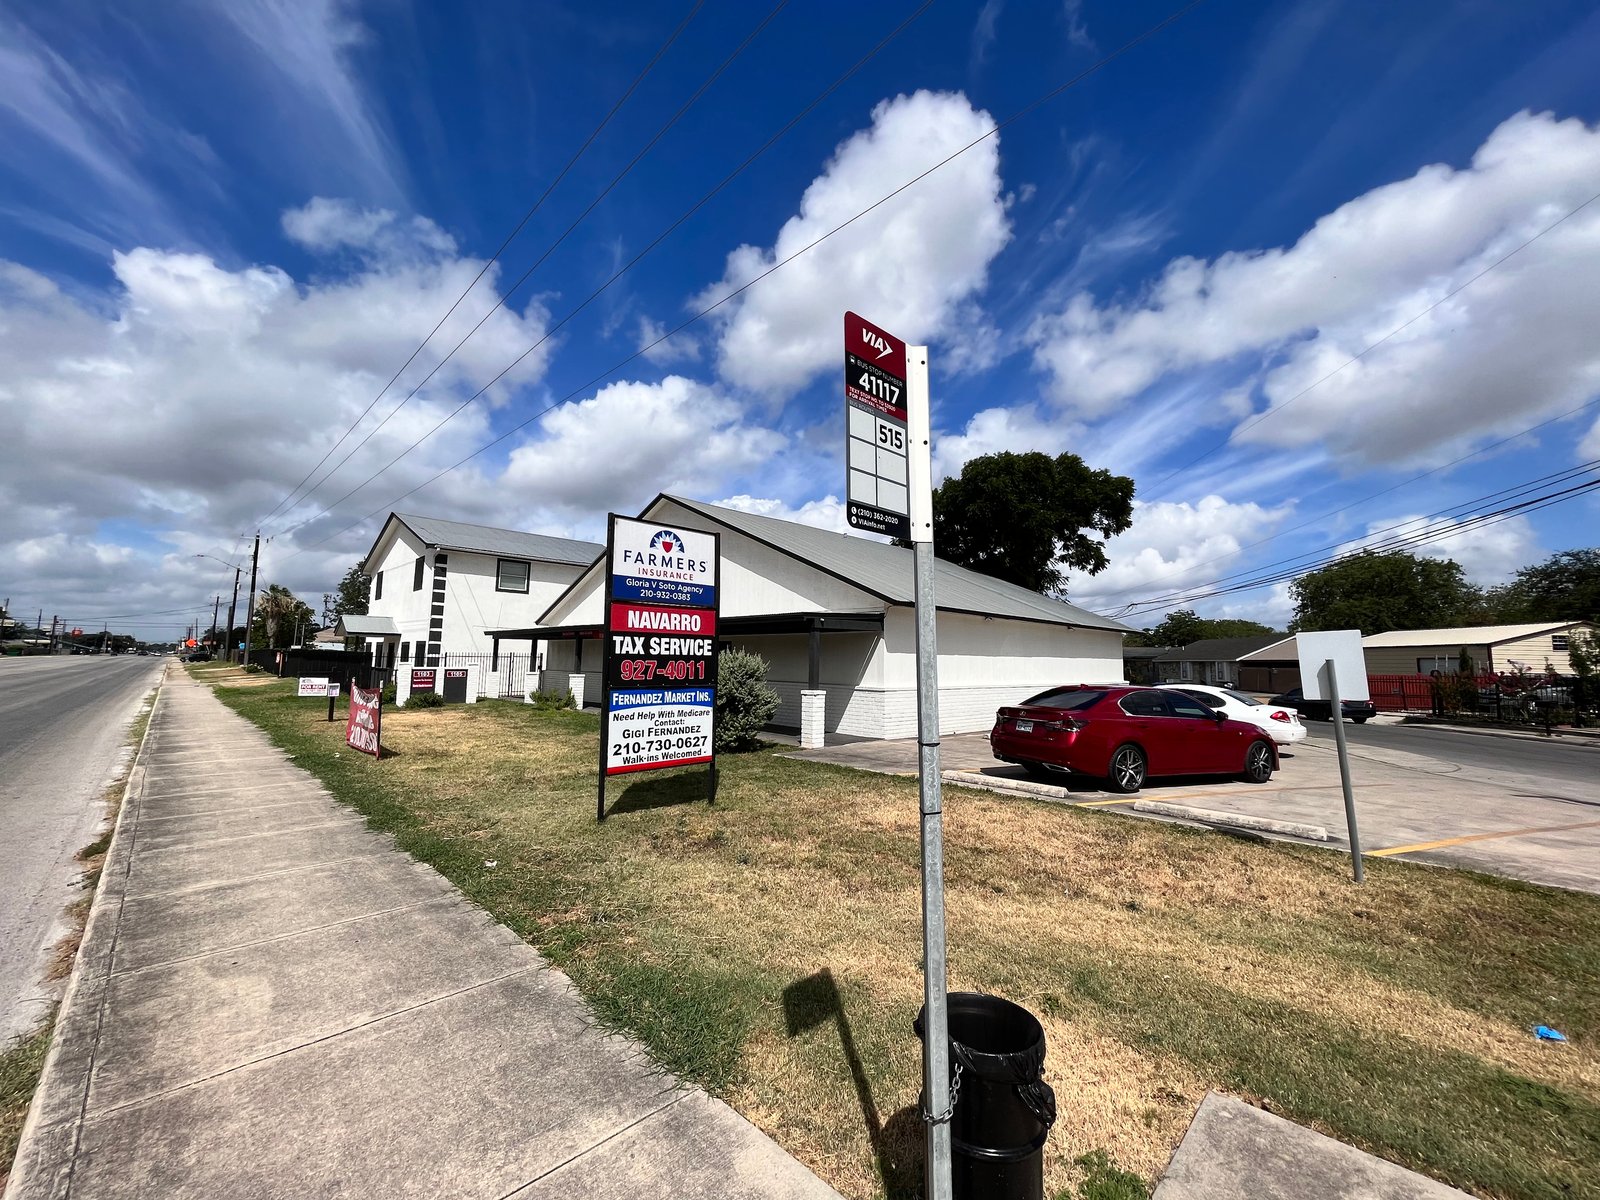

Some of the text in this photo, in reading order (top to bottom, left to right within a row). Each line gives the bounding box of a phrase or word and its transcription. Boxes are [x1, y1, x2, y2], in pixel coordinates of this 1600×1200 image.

[862, 328, 885, 351] VIA
[857, 360, 903, 387] BUS STOP NUMBER
[859, 372, 899, 404] 41117
[859, 397, 875, 407] ARRIVAL
[876, 404, 887, 412] TIMES
[859, 404, 874, 414] ROUTES
[879, 424, 903, 449] 515
[858, 509, 898, 524] (210) 362-2020
[858, 518, 886, 530] VIAinfo.net
[624, 550, 706, 572] FARMERS
[638, 568, 694, 580] INSURANCE
[626, 578, 649, 588] Gloria
[659, 582, 676, 590] Soto
[678, 584, 704, 595] Agency
[640, 590, 690, 601] 210-932-0383
[628, 610, 701, 632] NAVARRO
[613, 636, 712, 656] TAX SERVICE
[620, 660, 705, 680] 927-4011
[613, 691, 710, 706] FERNANDEZ MARKET INS.
[613, 709, 710, 722] Need Help With Medicare
[622, 726, 701, 738] GIGI FERNANDEZ
[613, 736, 708, 756] 210-730-0627
[622, 749, 702, 765] Walk-ins Welcomed
